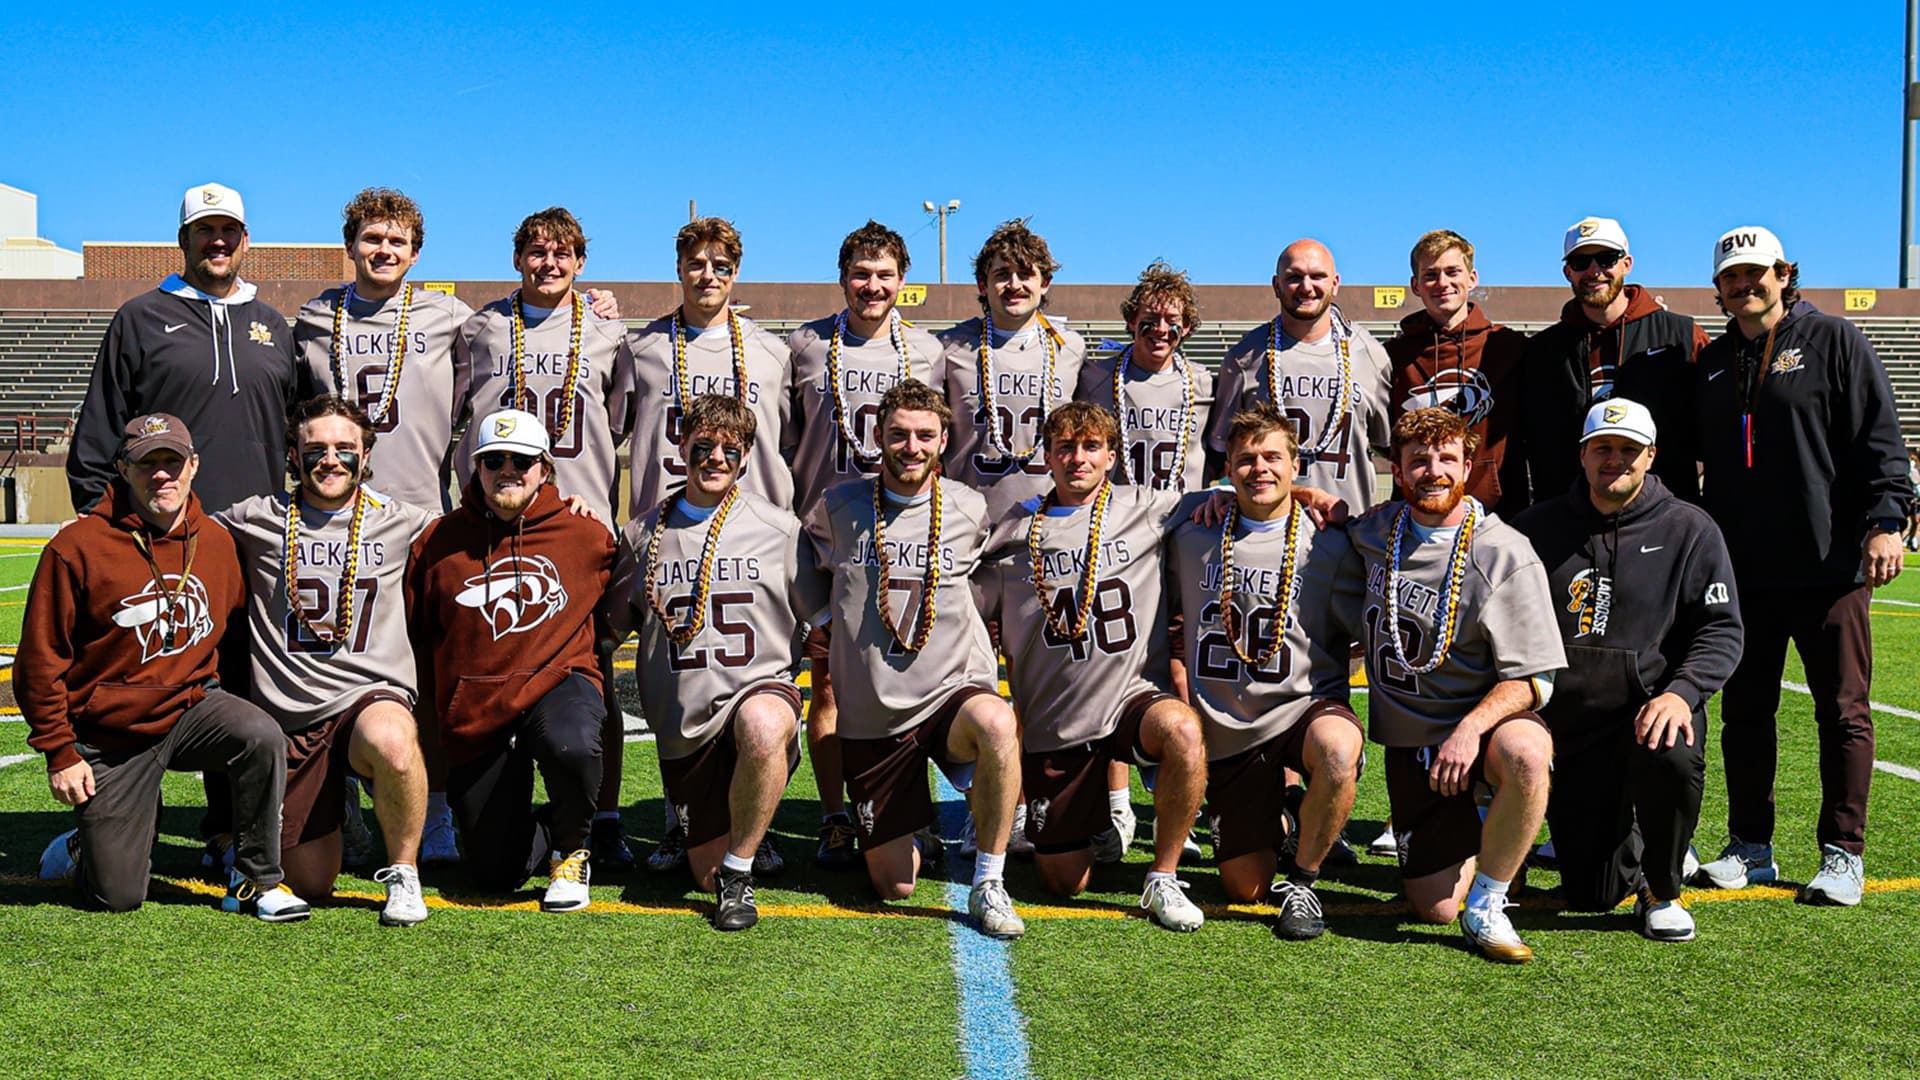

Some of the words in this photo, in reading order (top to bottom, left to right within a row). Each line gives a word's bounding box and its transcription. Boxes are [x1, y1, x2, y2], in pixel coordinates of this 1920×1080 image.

[1722, 233, 1757, 254] BW
[902, 292, 917, 303] 14
[1382, 294, 1397, 305] 15
[1853, 297, 1868, 308] 16
[330, 332, 427, 355] CKES
[492, 352, 591, 380] JCKES
[816, 369, 901, 394] JCKET
[661, 373, 761, 405] JCKES
[968, 372, 1063, 399] JCKES
[1267, 374, 1364, 405] ACKES
[1124, 406, 1199, 435] ACKES
[281, 540, 386, 568] ACKTS
[851, 538, 954, 573] JACKES
[1029, 538, 1131, 583] ACKTS
[656, 556, 761, 588] JACETS
[1199, 562, 1304, 601] JACKES
[1367, 562, 1450, 622] JAKETS
[1591, 576, 1613, 637] LACROSSE
[1704, 582, 1729, 605] KD
[284, 575, 380, 656] 27
[663, 589, 758, 674] 25
[885, 575, 926, 657] 7
[1041, 574, 1140, 663] 48
[1195, 599, 1295, 685] 26
[1364, 603, 1421, 696] 12
